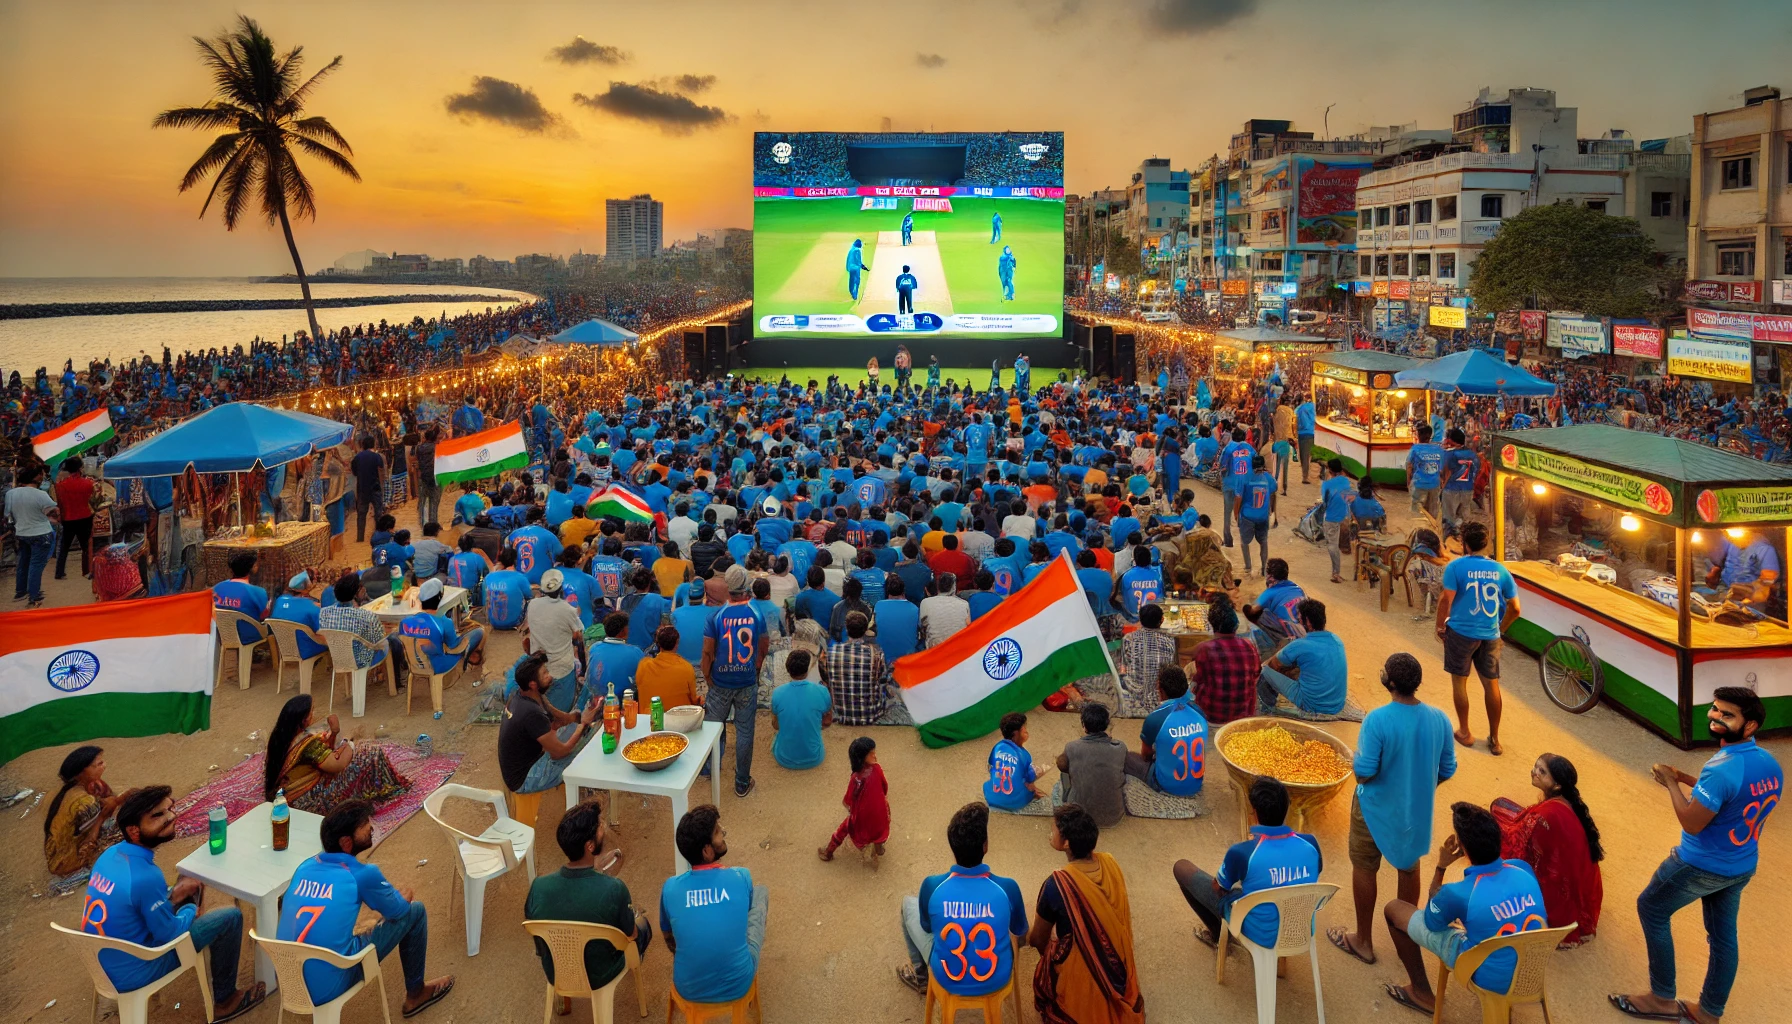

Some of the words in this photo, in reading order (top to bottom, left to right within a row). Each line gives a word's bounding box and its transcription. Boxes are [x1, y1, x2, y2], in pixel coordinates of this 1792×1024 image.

[1171, 737, 1205, 781] 39
[295, 905, 327, 943] 7
[940, 922, 998, 982] 33
